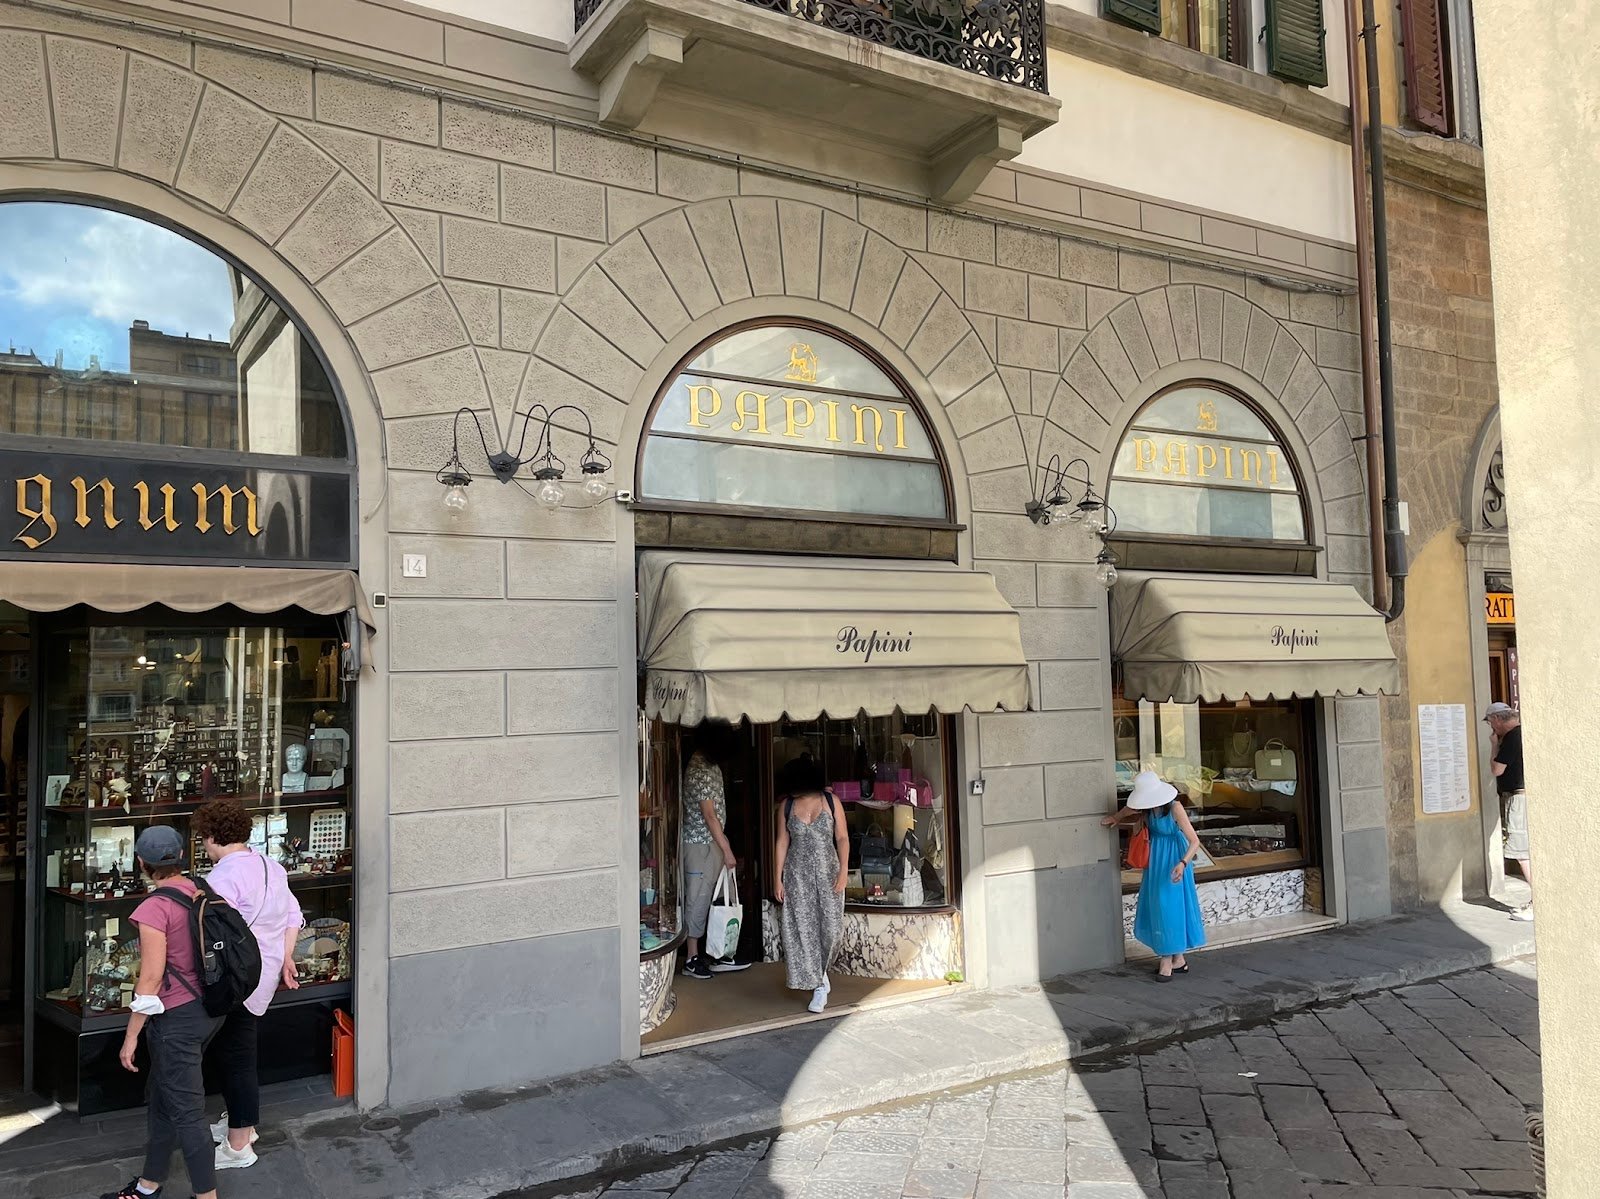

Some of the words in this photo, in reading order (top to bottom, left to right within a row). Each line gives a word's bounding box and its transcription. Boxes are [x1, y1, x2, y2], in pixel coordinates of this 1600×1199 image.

[684, 383, 909, 452] PAPINI
[1132, 437, 1280, 486] PAPINI
[12, 473, 264, 549] gnum
[407, 559, 423, 575] 14
[835, 625, 913, 663] Papini
[1270, 625, 1319, 654] Papini
[652, 676, 689, 709] Papini
